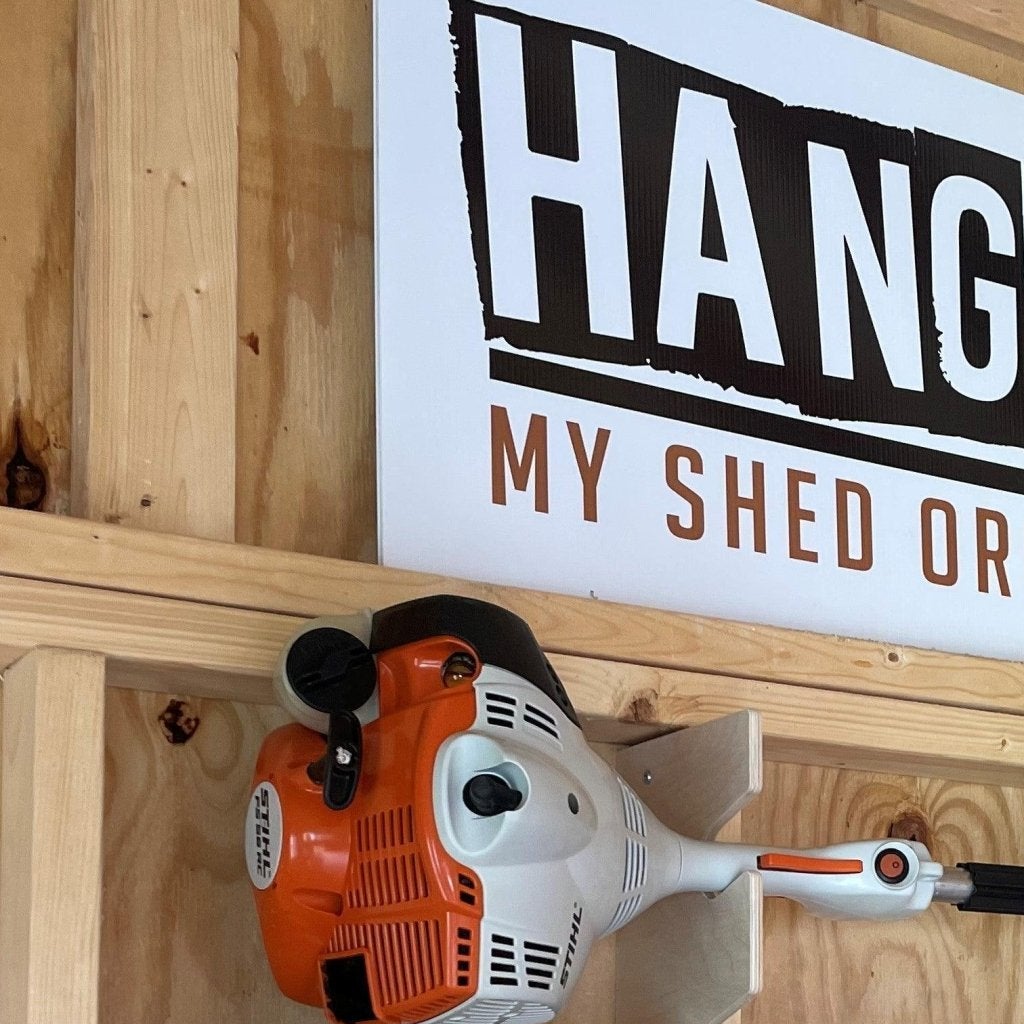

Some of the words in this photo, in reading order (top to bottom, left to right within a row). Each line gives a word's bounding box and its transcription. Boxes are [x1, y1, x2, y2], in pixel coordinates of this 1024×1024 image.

[490, 404, 611, 523] MY
[664, 444, 874, 571] SHED
[260, 787, 271, 878] STIHL
[560, 906, 582, 989] STIHL
